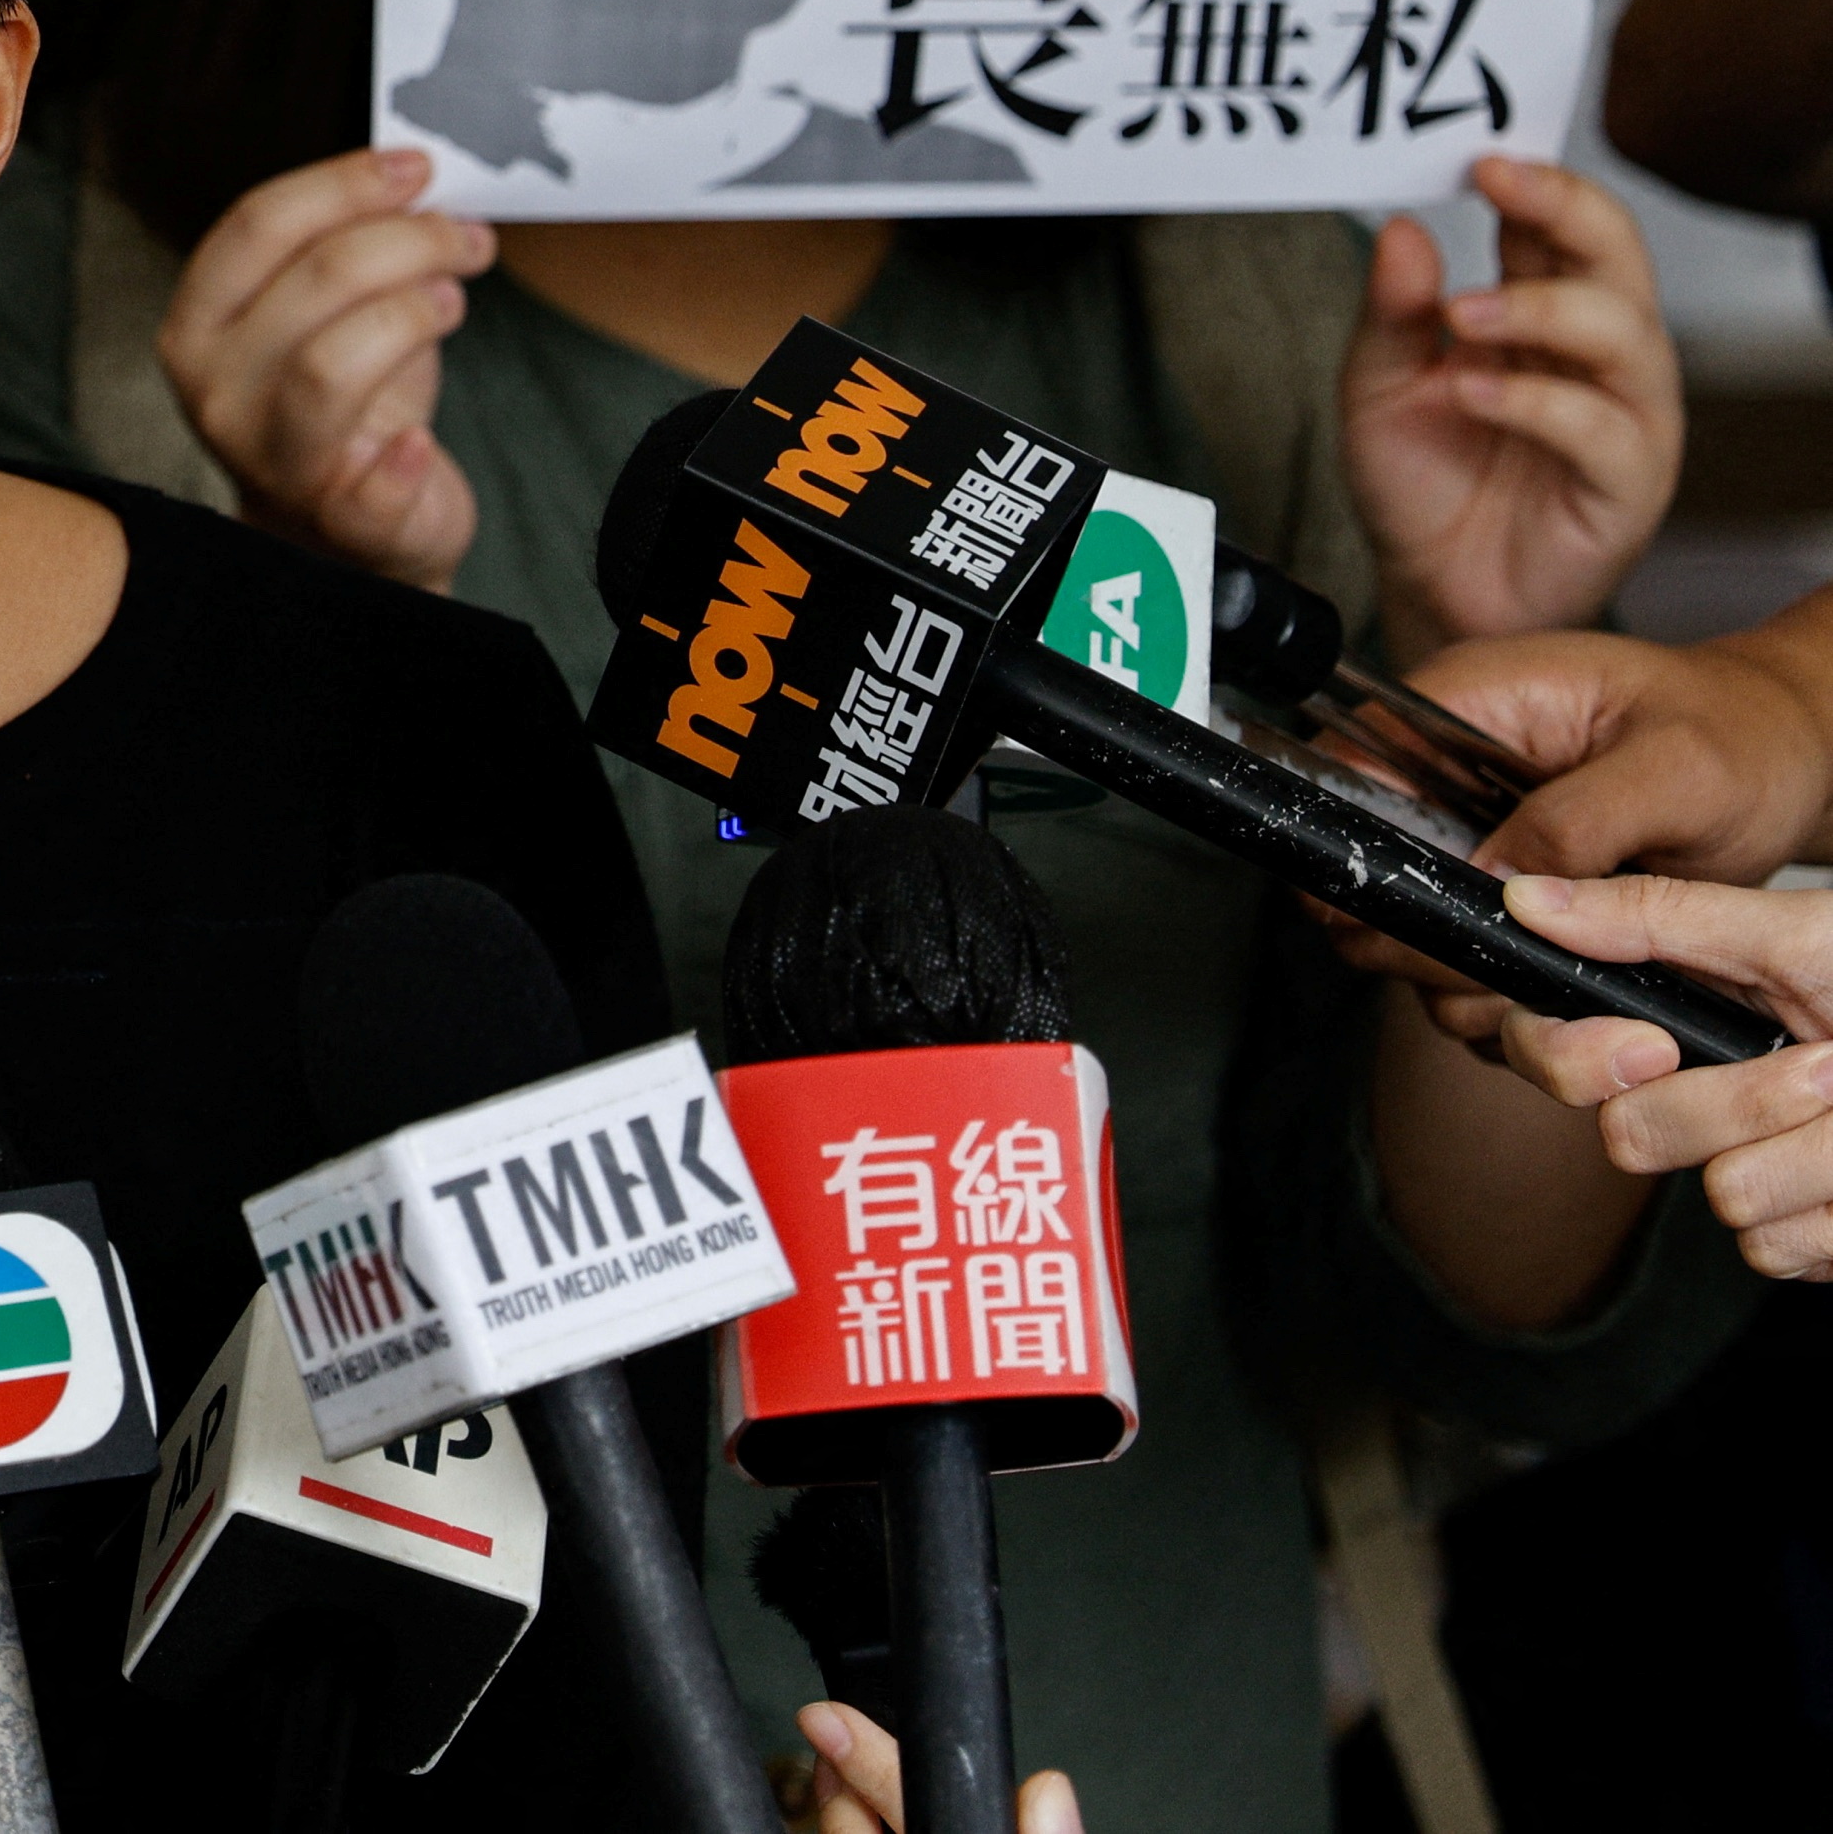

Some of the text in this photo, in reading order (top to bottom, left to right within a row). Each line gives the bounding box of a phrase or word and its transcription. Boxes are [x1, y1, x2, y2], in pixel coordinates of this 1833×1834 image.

[764, 356, 928, 518] now
[909, 429, 1076, 591] 新聞台
[656, 518, 812, 779] now
[1088, 570, 1141, 692] FA
[430, 1096, 744, 1285] TMHK
[822, 1119, 1073, 1255] 有線
[264, 1198, 438, 1360] TMHK
[477, 1213, 758, 1330] TRUTH MEDIA HONG KONG
[833, 1251, 1089, 1388] 新聞
[157, 1383, 228, 1547] AP
[381, 1410, 493, 1477] P
